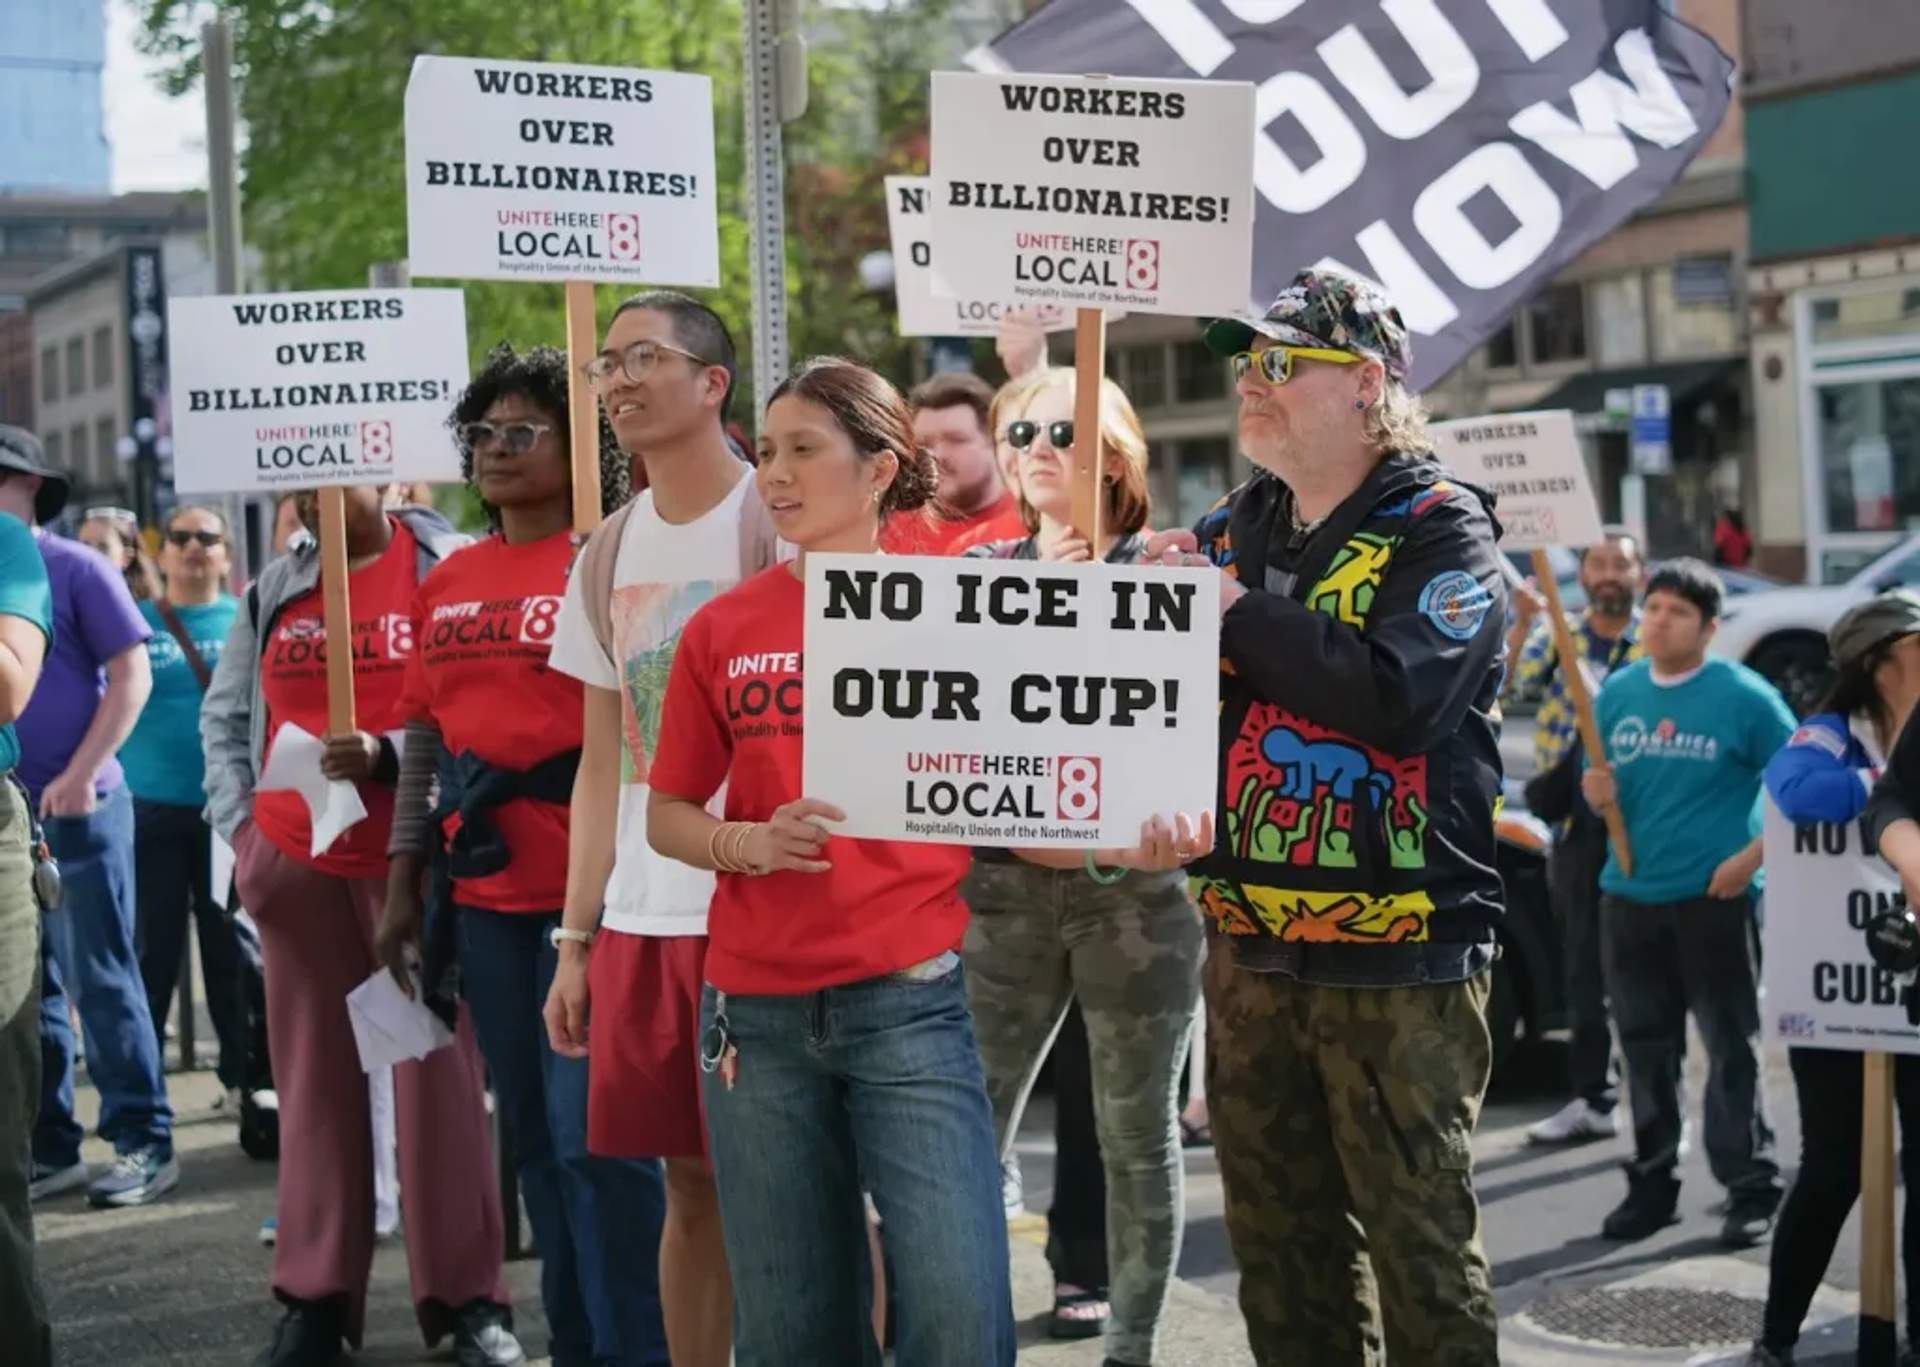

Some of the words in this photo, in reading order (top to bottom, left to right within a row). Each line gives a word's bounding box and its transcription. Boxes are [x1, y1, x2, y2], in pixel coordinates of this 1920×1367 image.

[474, 69, 653, 103] WORKERS
[1000, 84, 1186, 120] WORKERS
[520, 118, 615, 146] OVER
[1043, 136, 1140, 168] OVER
[426, 161, 697, 198] BILLIONAIRES!
[898, 188, 930, 214] N
[949, 181, 1231, 223] BILLIONAIRES!
[498, 210, 604, 229] UNITEHERE!
[498, 231, 602, 258] LOCAL
[608, 213, 640, 260] 8
[1016, 233, 1123, 255] UNITEHERE!
[1016, 255, 1118, 287] LOCAL
[1126, 239, 1159, 291] 8
[233, 298, 404, 326] WORKERS
[276, 341, 366, 365] OVER
[189, 380, 450, 412] BILLIONAIRES!
[257, 443, 354, 469] LOCAL
[361, 421, 392, 463] 8
[1453, 422, 1538, 443] WORKERS
[1481, 452, 1527, 470] OVER
[1489, 477, 1577, 496] ONAIRES!
[824, 570, 922, 622] NO
[955, 574, 1078, 629] ICE
[1110, 581, 1197, 633] IN
[525, 599, 560, 641] 8
[725, 679, 804, 720] LOC
[832, 667, 981, 721] OUR
[1010, 673, 1180, 728] CUP!
[907, 752, 1052, 776] UNITEHERE!
[906, 780, 1045, 819] LOCAL
[1057, 756, 1100, 821] 8
[906, 821, 967, 838] Hospitality
[968, 823, 1001, 838] Union
[1004, 824, 1015, 838] of
[1016, 825, 1038, 839] the
[1040, 827, 1099, 840] Northwest
[1813, 960, 1908, 1006] CUB
